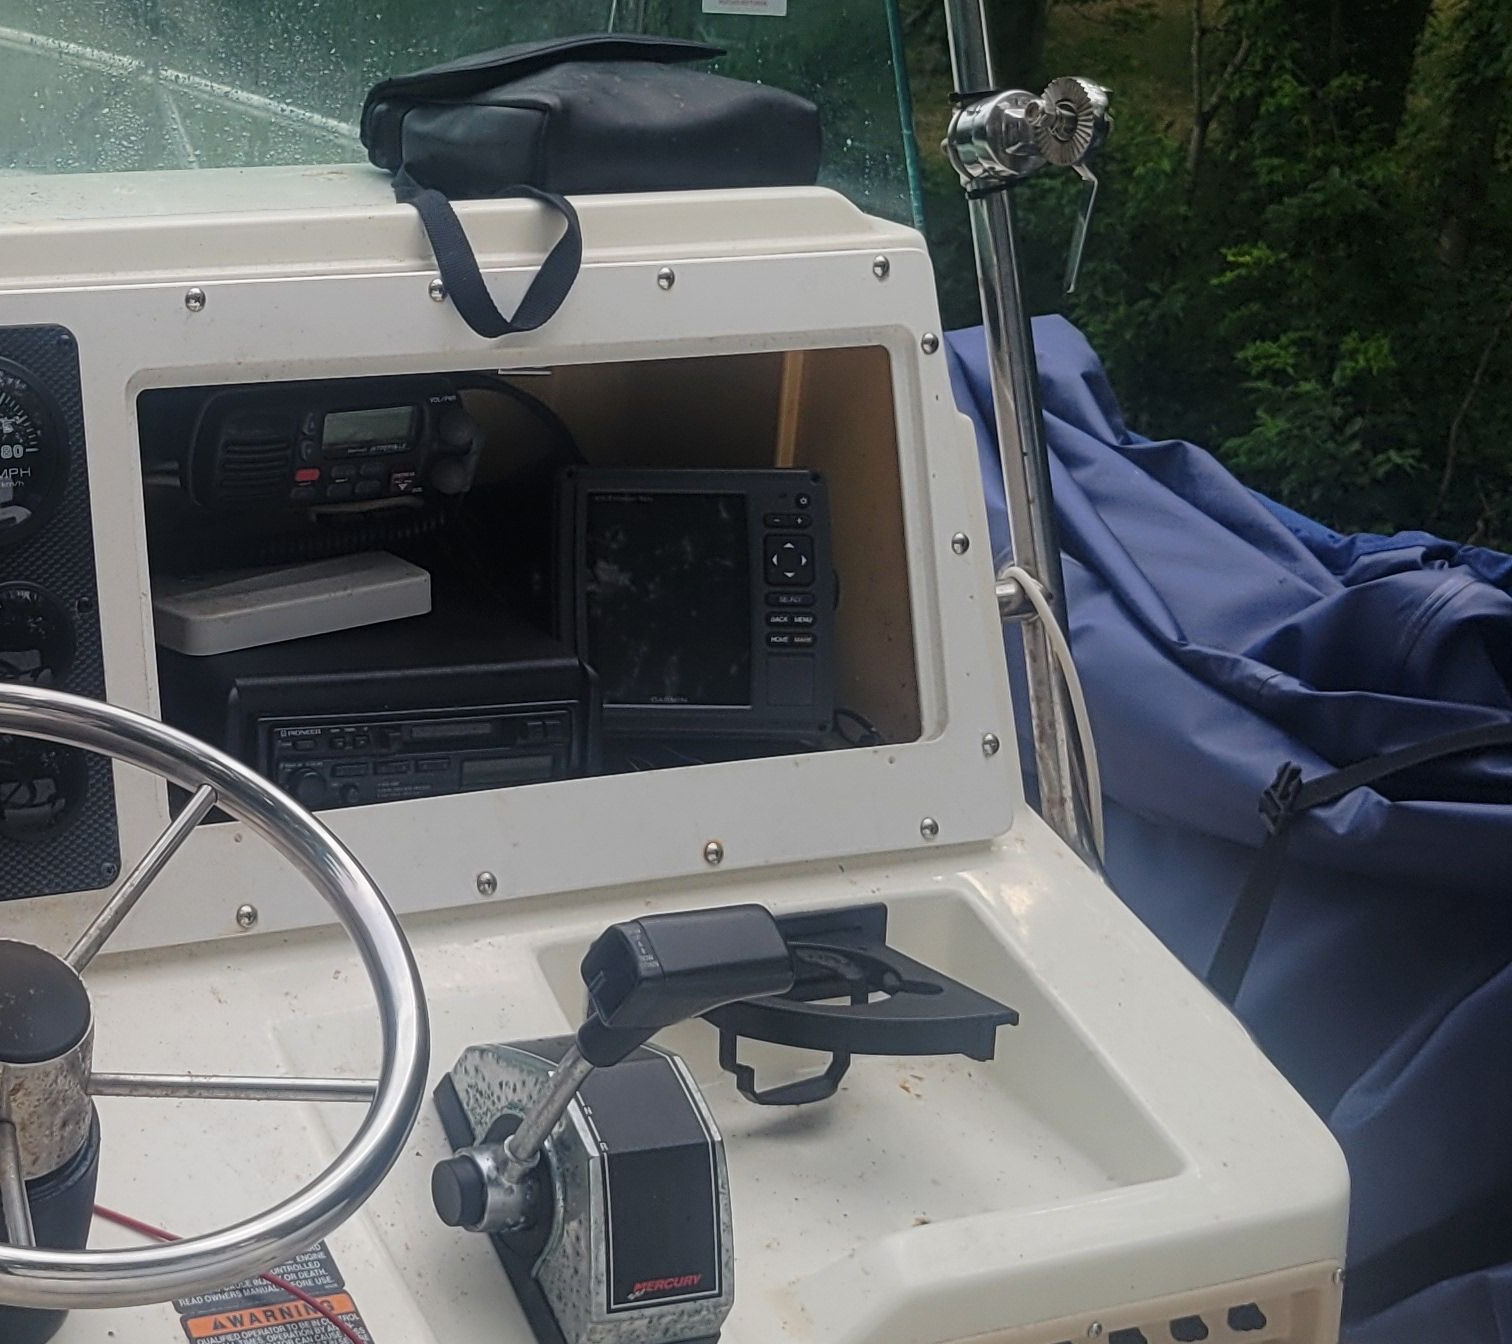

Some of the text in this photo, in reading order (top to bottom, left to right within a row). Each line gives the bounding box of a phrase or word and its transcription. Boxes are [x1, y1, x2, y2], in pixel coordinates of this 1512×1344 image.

[1, 444, 24, 459] 80
[633, 1274, 702, 1292] MERCURY
[178, 1297, 203, 1307] READ
[228, 1299, 335, 1328] WARNING
[241, 1324, 286, 1339] OPERATOR
